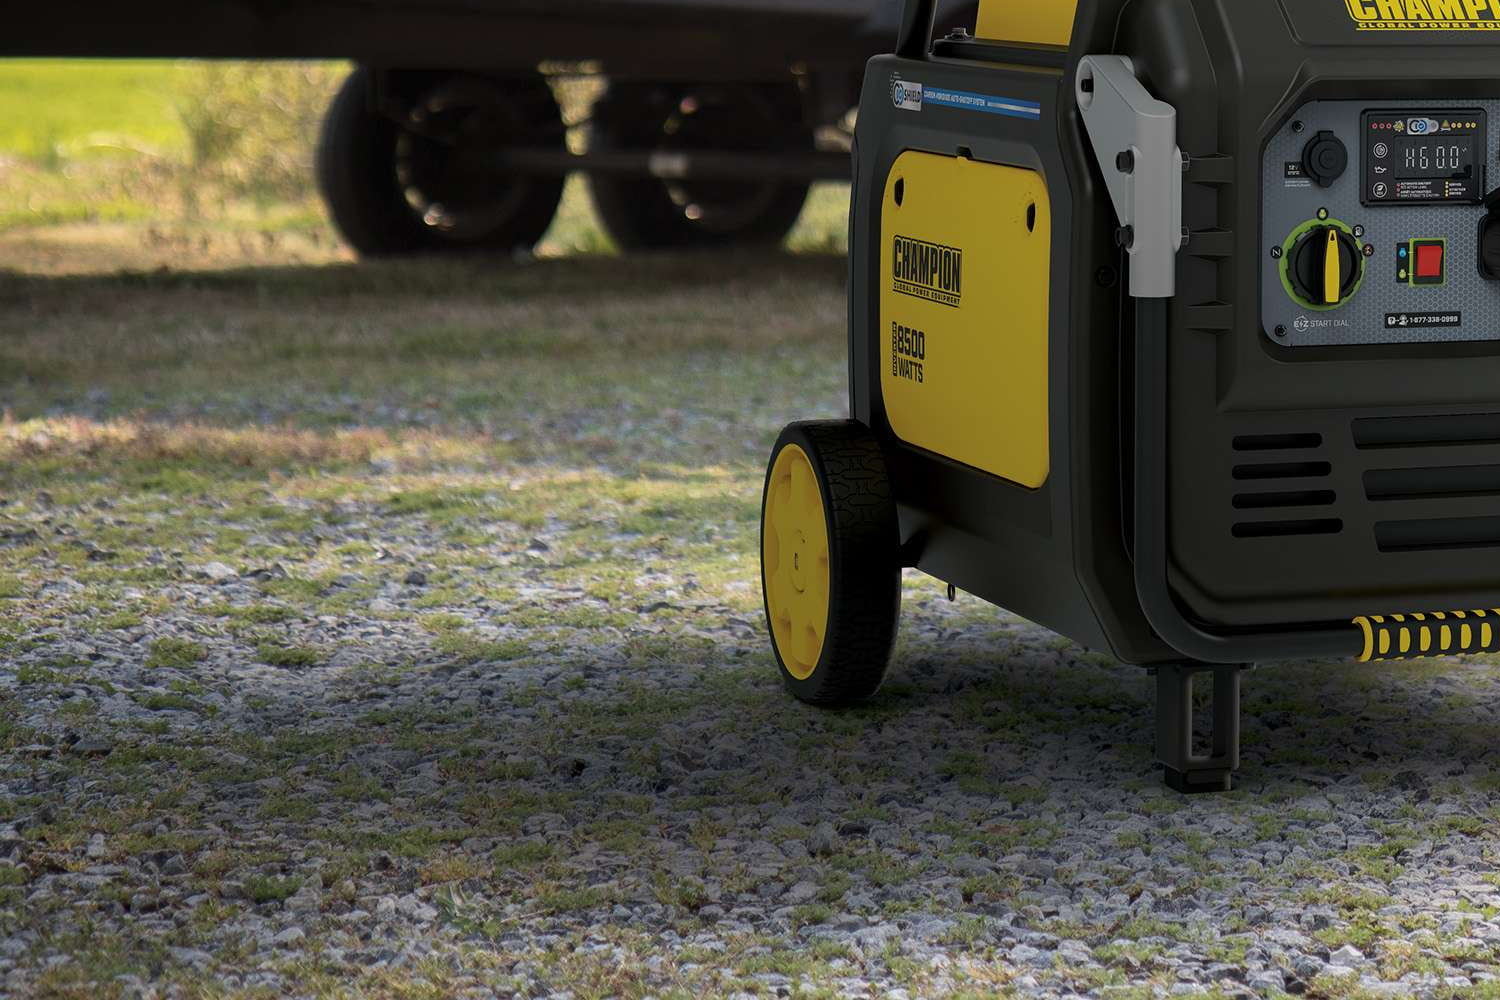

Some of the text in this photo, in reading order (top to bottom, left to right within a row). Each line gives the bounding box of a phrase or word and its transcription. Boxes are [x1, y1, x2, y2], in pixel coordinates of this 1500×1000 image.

[894, 237, 961, 294] CHAMPION
[1310, 319, 1331, 327] START
[1333, 319, 1349, 327] DIAL
[897, 325, 925, 360] 8500
[897, 357, 923, 383] WATTS
